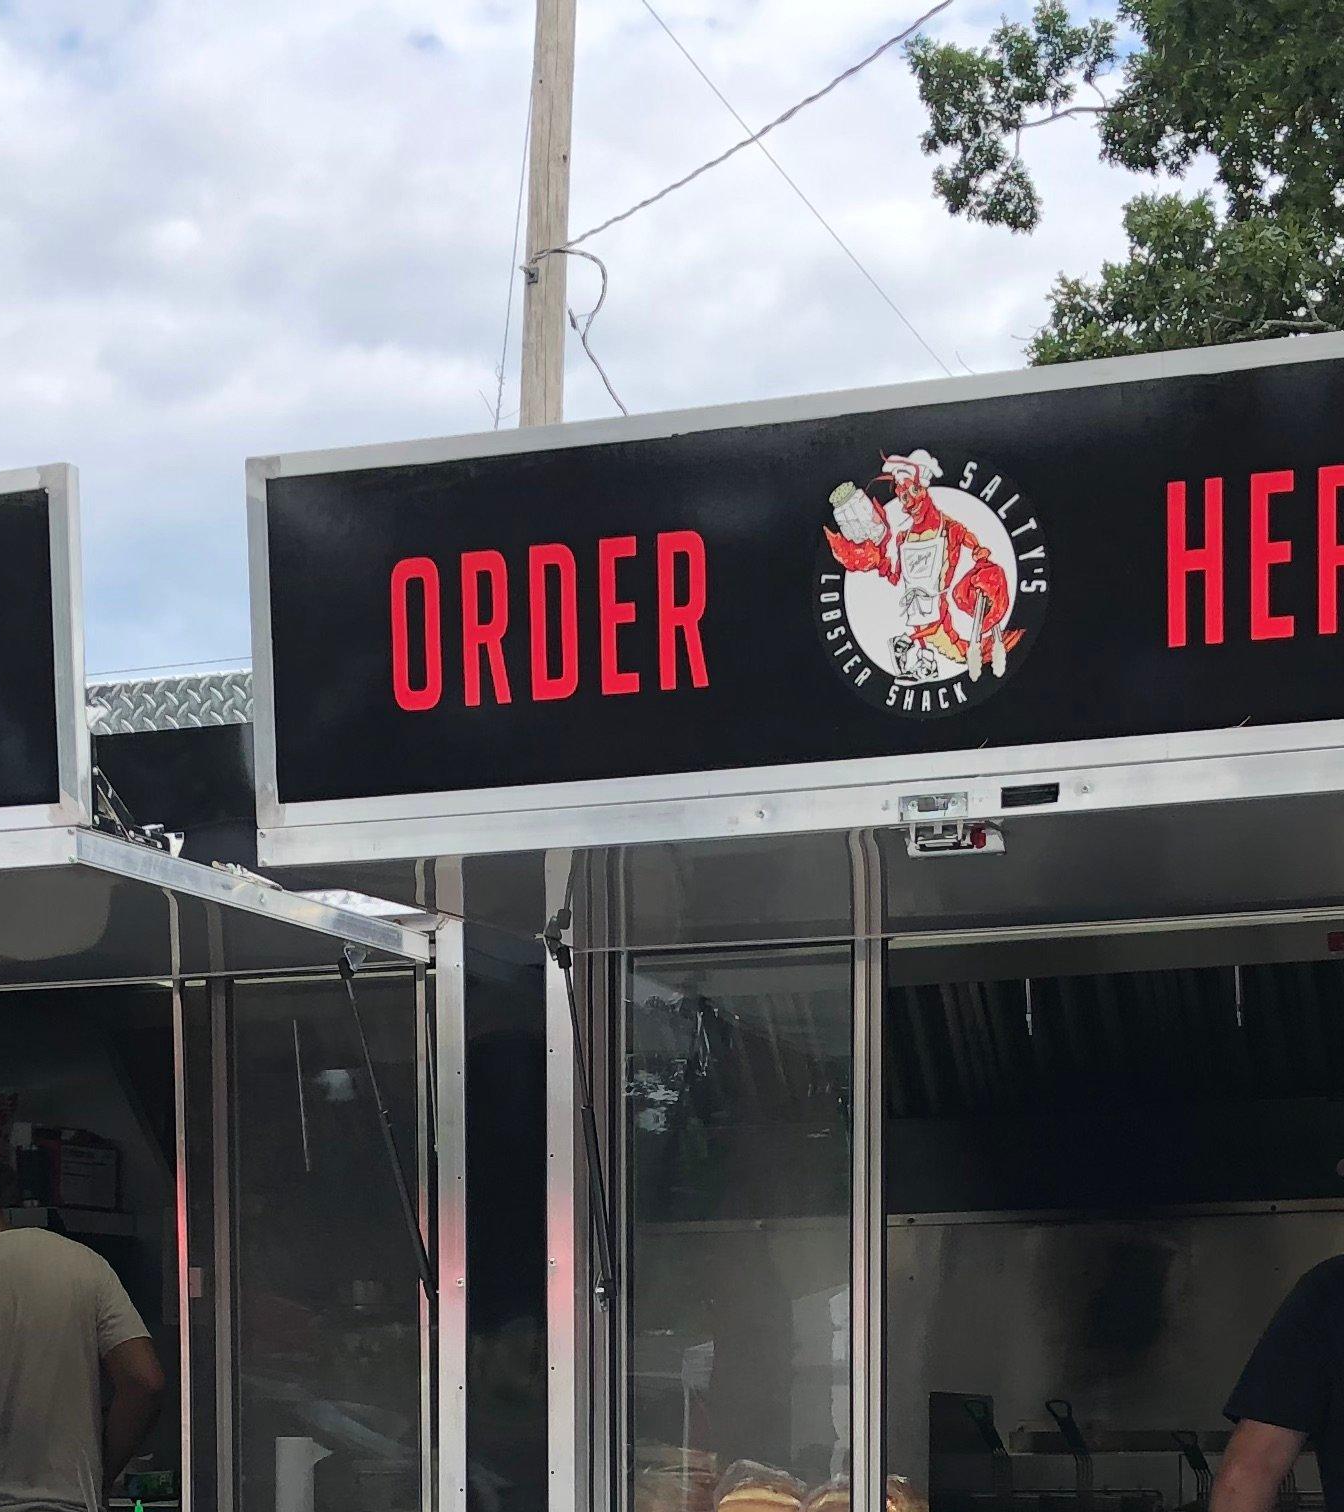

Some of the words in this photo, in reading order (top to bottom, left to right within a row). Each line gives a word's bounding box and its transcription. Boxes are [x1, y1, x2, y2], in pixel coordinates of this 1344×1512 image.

[959, 461, 1047, 593] SALTY'S
[391, 531, 708, 711] ORDER
[820, 573, 872, 687] LOBSTER
[886, 681, 968, 712] SHACK
